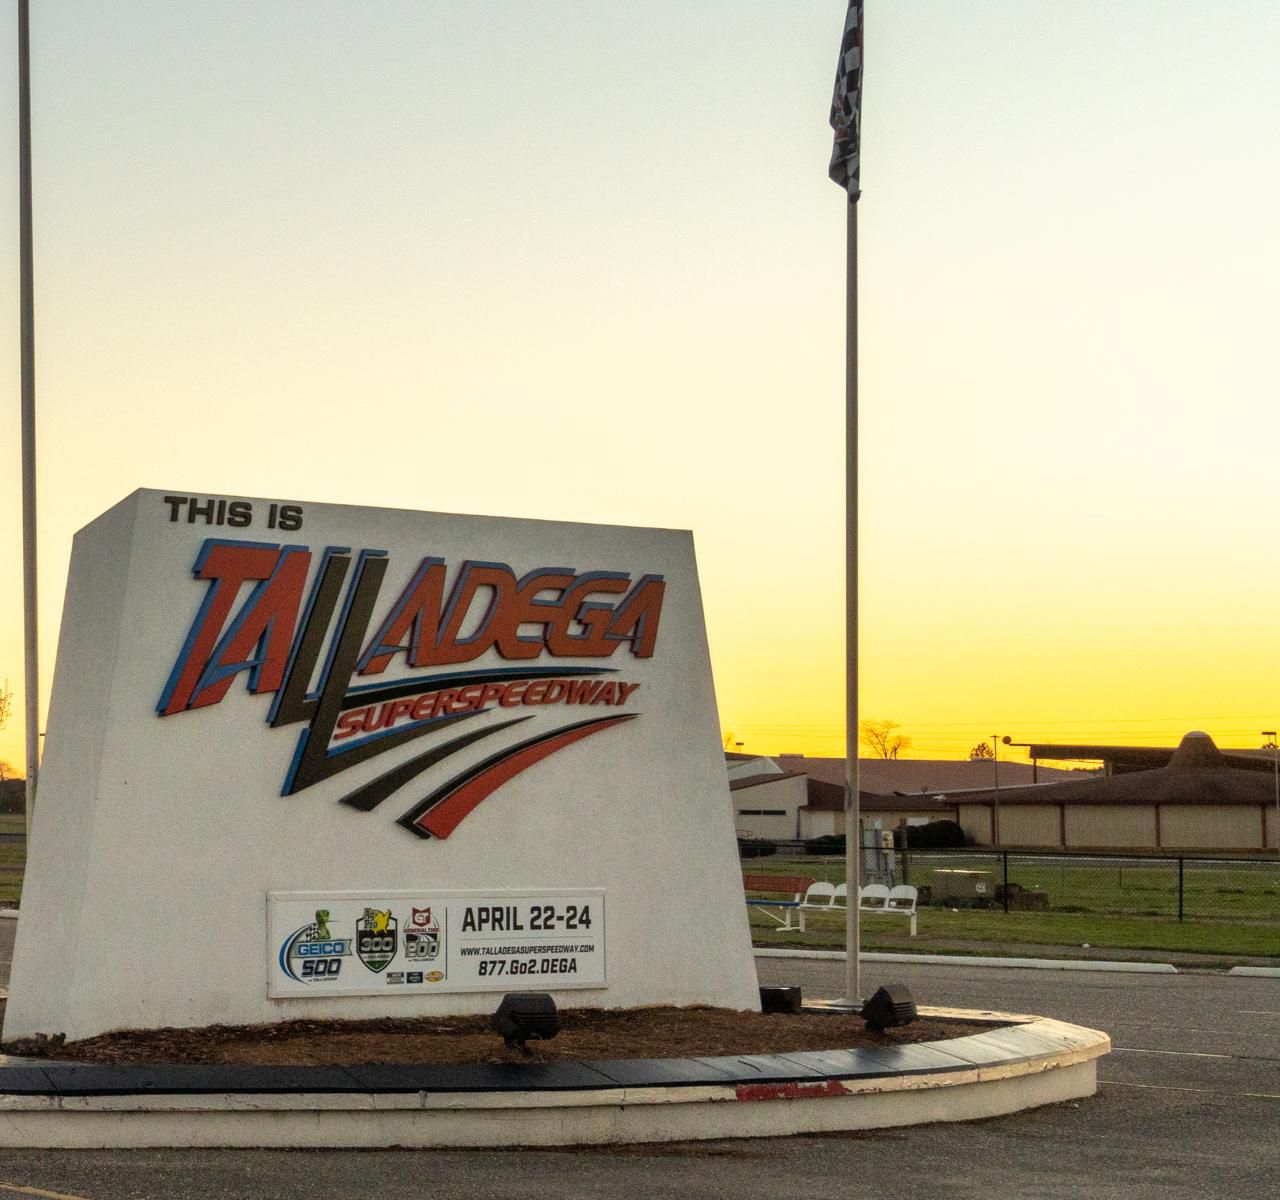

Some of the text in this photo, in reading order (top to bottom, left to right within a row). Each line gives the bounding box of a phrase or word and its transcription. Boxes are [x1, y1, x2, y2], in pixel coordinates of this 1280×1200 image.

[164, 495, 303, 531] THIS IS
[155, 538, 666, 797] TALLADEGA
[333, 679, 641, 741] SUPERSPEEDWAY
[462, 905, 592, 932] APRIL 22-24
[298, 942, 344, 955] GEICO
[360, 937, 394, 952] 300
[405, 941, 440, 958] 200
[460, 945, 595, 956] WWW.TALLADEGASUPERSPEEDWAY.COM
[301, 958, 342, 978] 500
[478, 958, 577, 976] 877.Go2.DEGA
